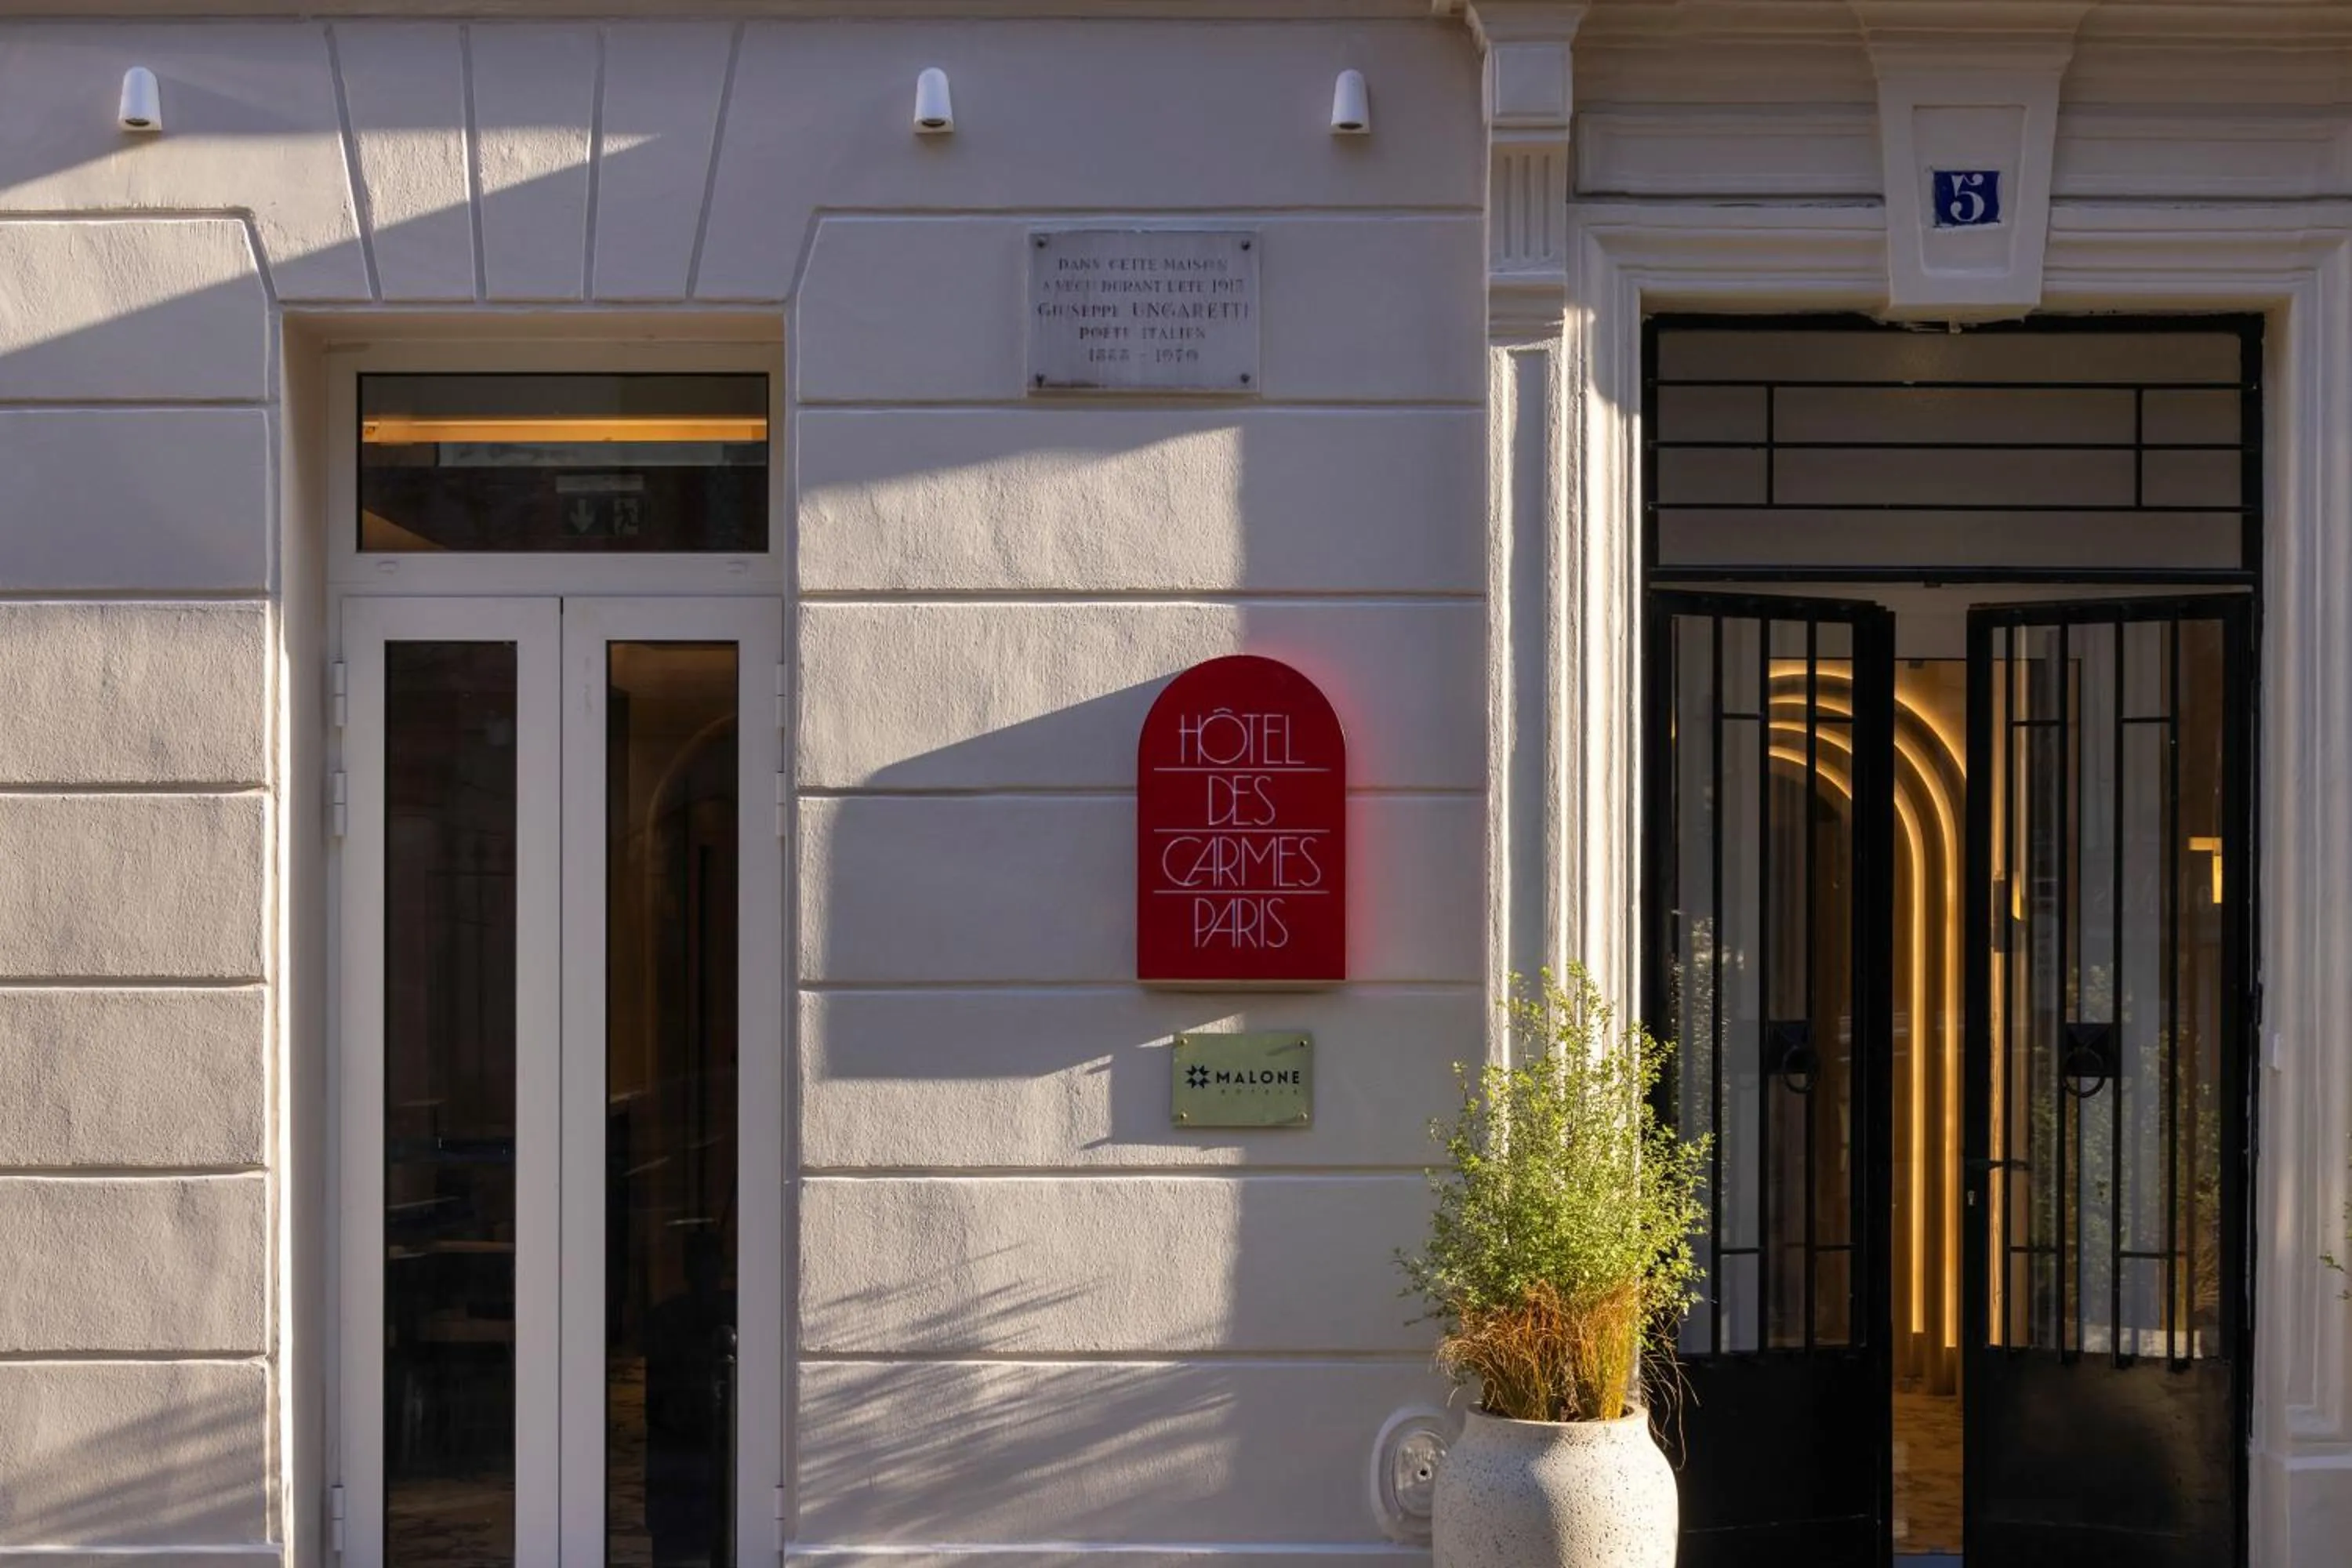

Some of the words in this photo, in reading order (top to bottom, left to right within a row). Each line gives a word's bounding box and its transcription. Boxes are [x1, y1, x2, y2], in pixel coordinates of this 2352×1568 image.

[1950, 173, 1985, 222] 5
[1108, 257, 1158, 271] CETTE
[1132, 302, 1249, 320] UNGARETTI
[1178, 707, 1305, 765] HÔTEL
[1207, 775, 1276, 826] DES
[1162, 836, 1322, 887] CARMES
[1193, 897, 1290, 949] PARIS
[1216, 1070, 1300, 1084] MALONE
